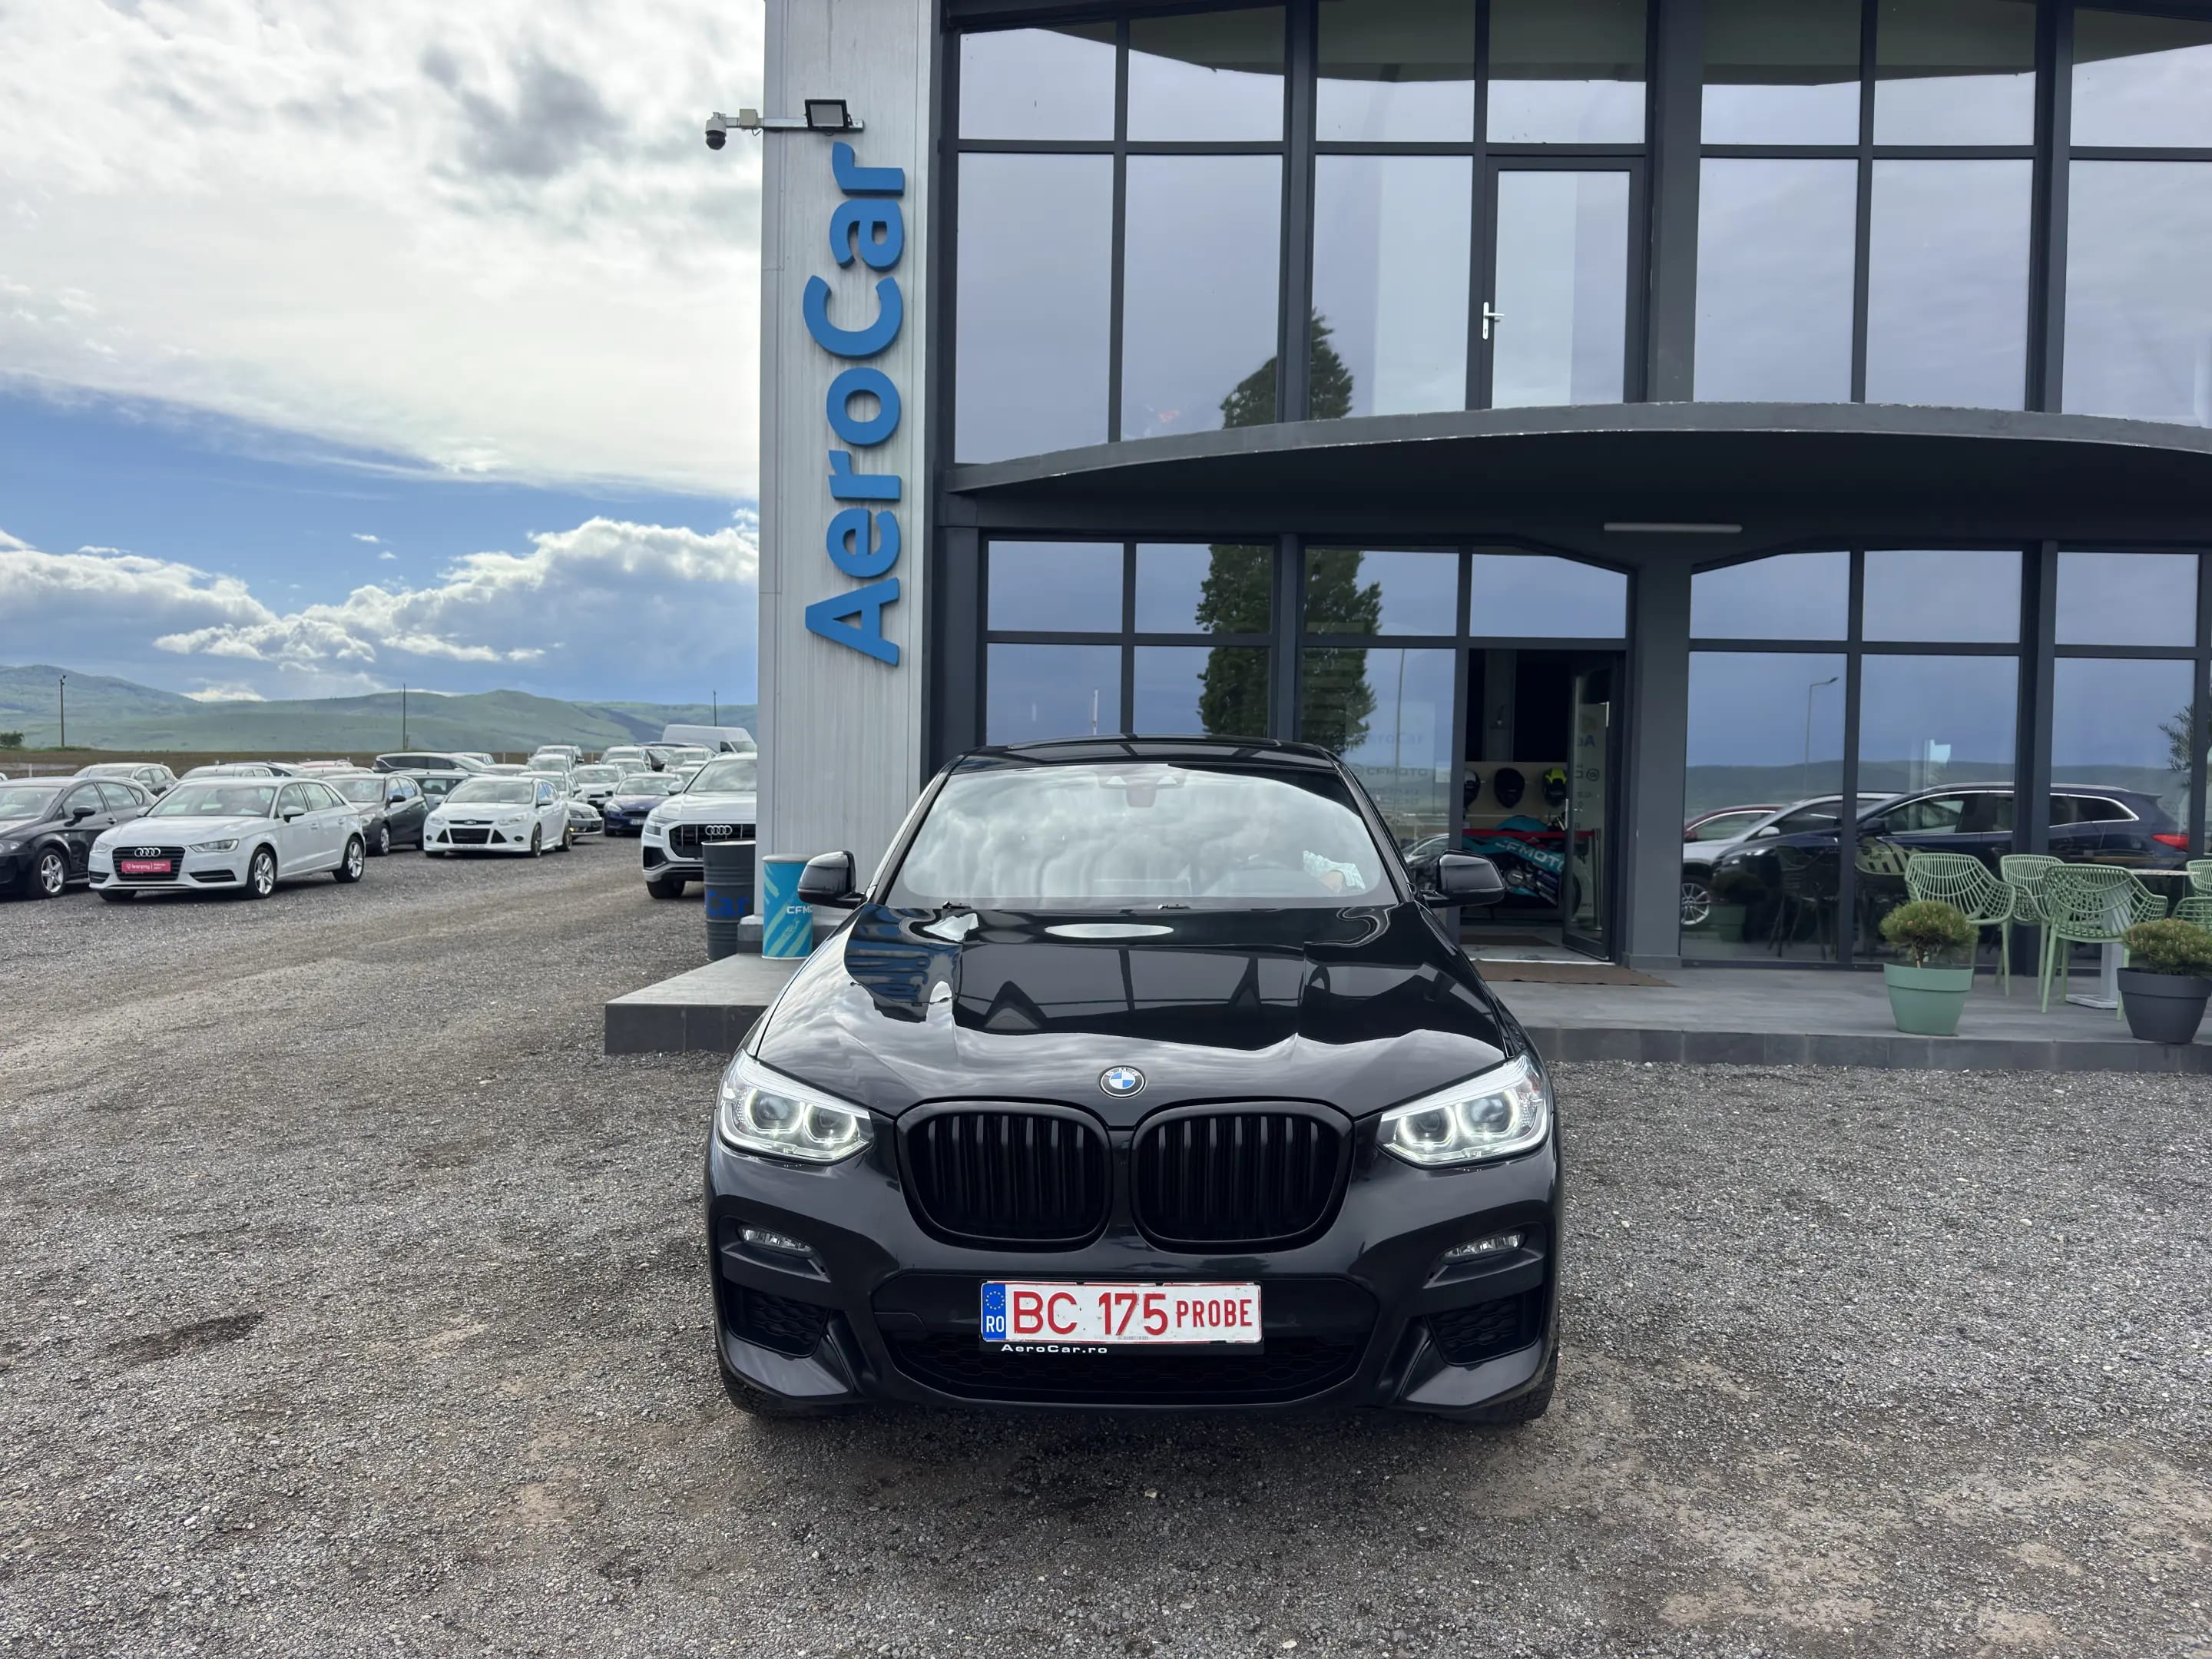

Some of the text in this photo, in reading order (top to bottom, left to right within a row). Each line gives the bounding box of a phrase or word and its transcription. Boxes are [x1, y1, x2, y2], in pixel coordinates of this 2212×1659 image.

[803, 141, 905, 667] AeroCar
[706, 890, 750, 916] Car
[1105, 1068, 1140, 1077] BMW
[985, 1315, 1005, 1333] RO
[1013, 1291, 1253, 1336] BC 175 PROBE
[1001, 1344, 1108, 1353] AeroCar.ro
